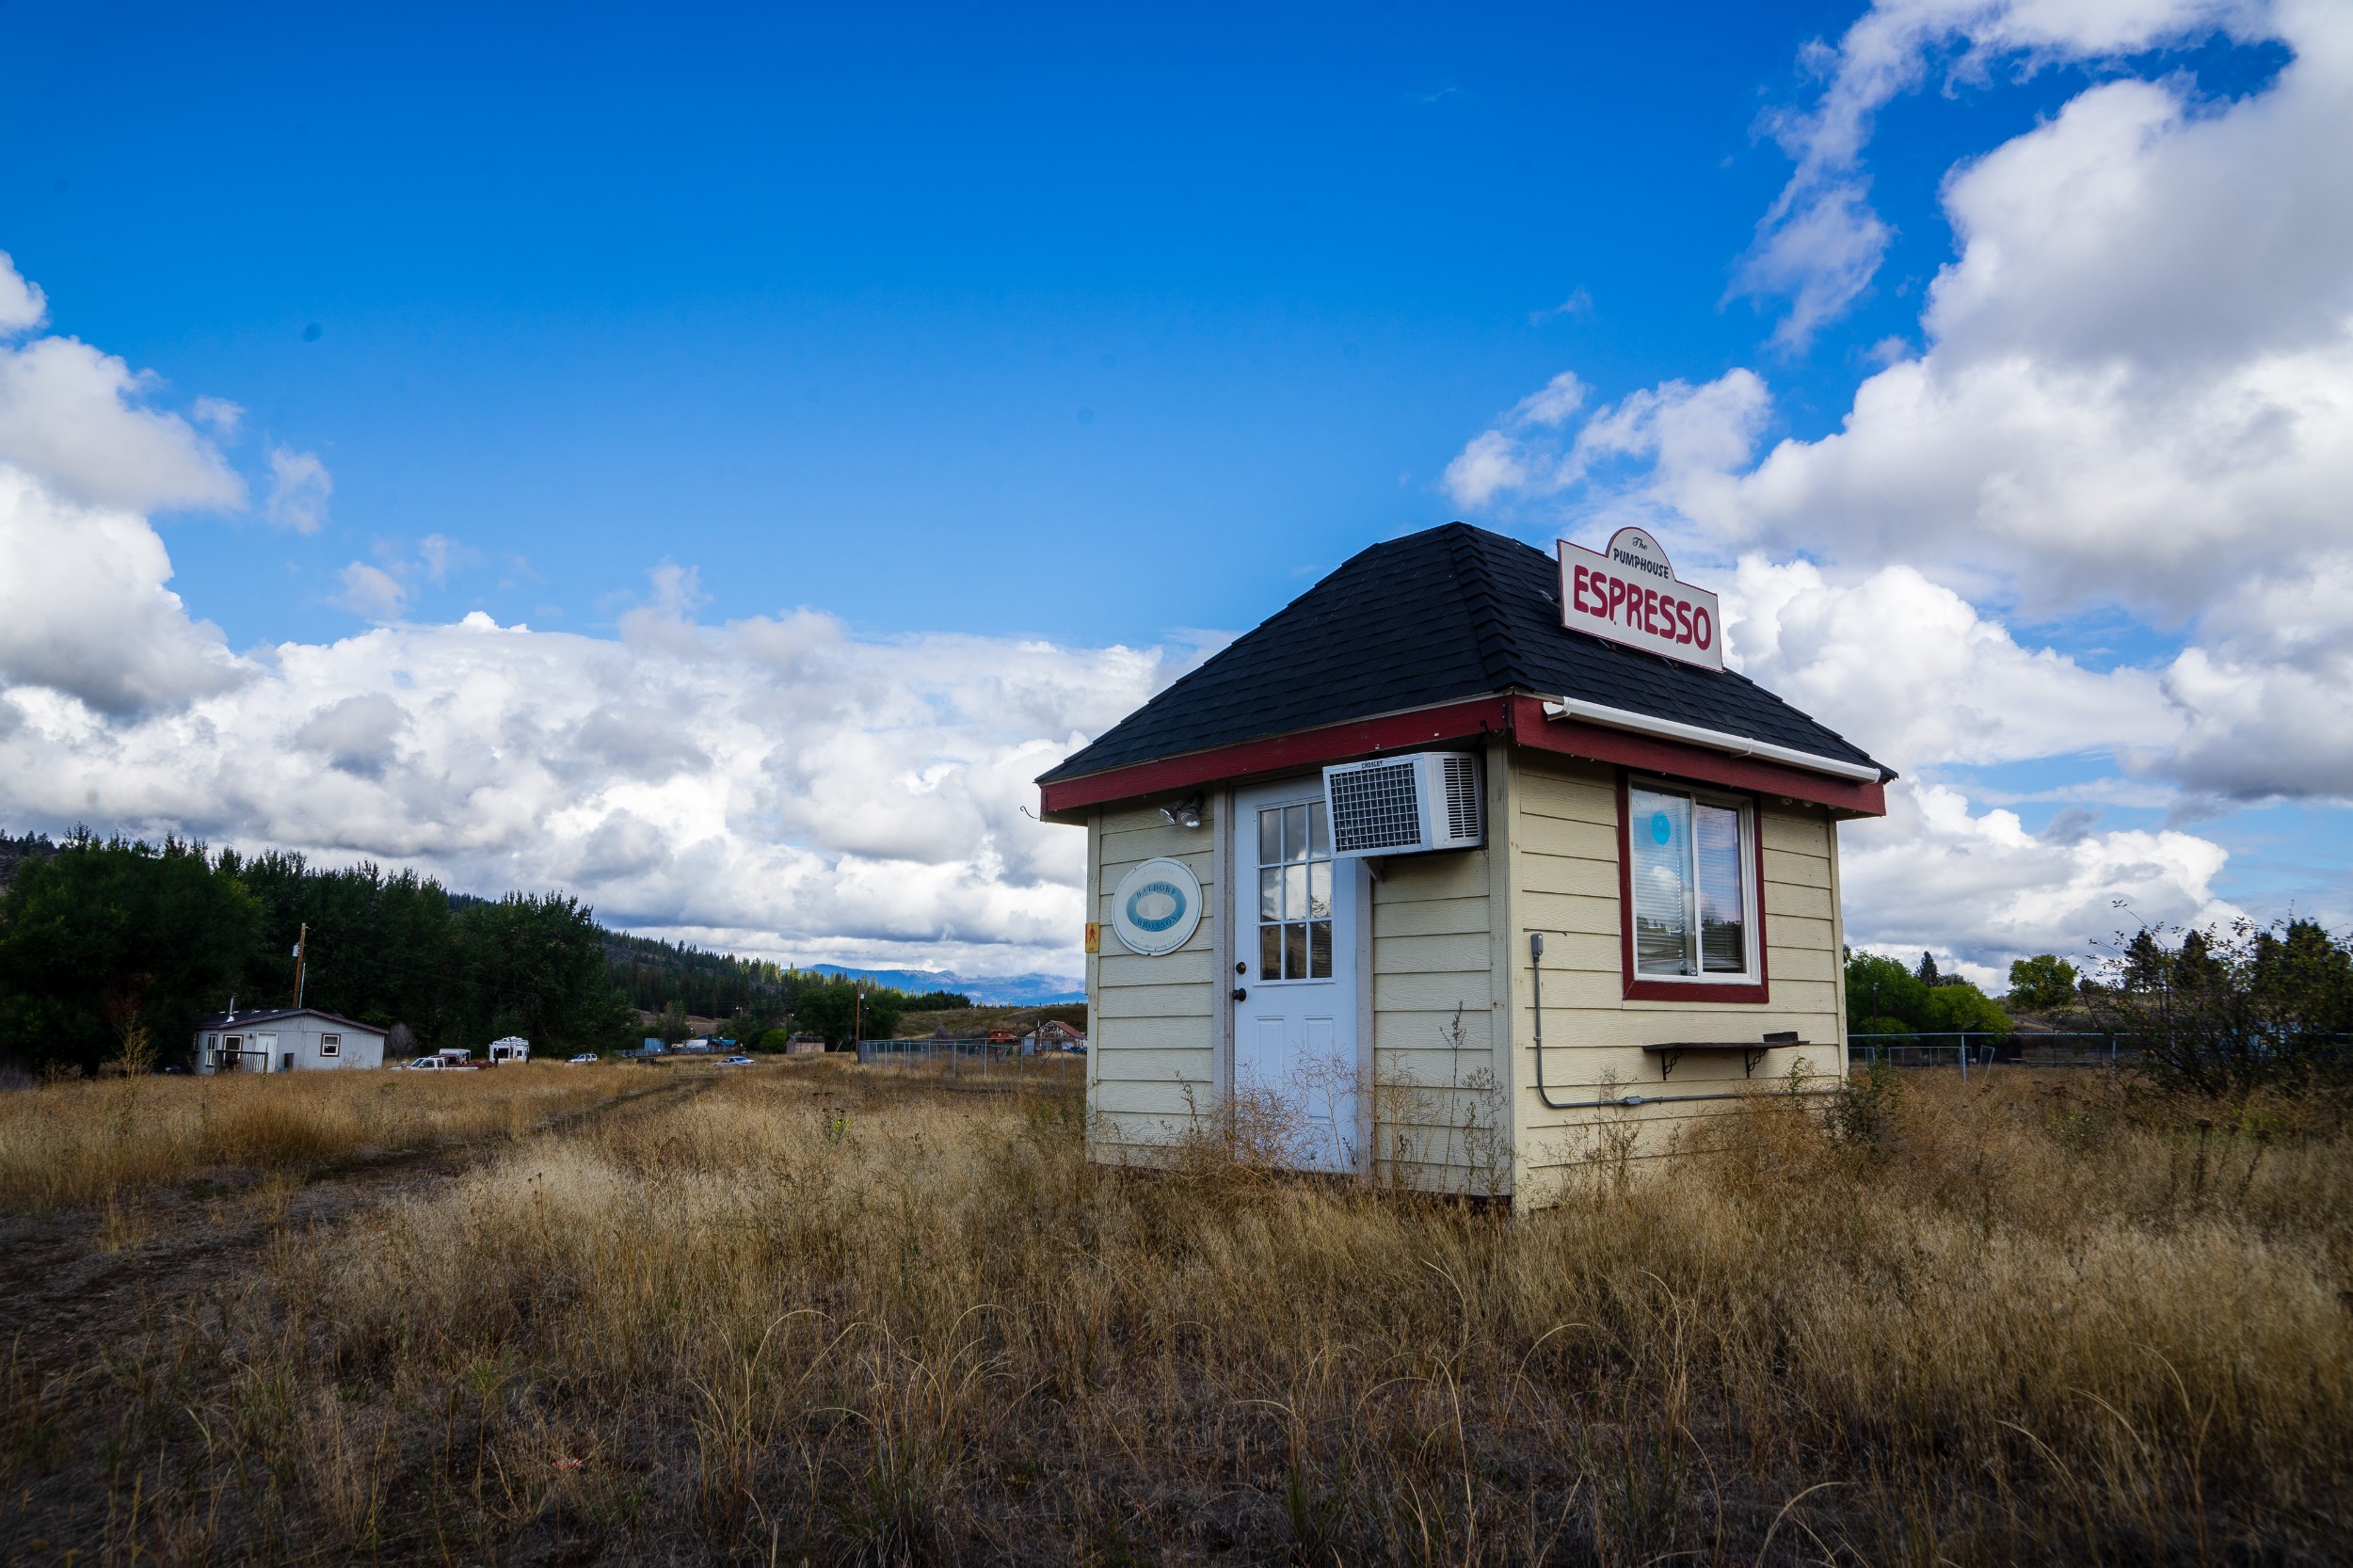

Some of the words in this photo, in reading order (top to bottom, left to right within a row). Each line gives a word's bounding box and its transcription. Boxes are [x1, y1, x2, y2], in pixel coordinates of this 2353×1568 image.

[1632, 536, 1648, 551] The
[1613, 548, 1669, 579] PUMPHOUSE
[1574, 565, 1711, 650] ESPRESSO
[1362, 760, 1384, 769] CROSLEY
[1136, 885, 1176, 899] BATDORF
[1136, 916, 1176, 929] BRONSON
